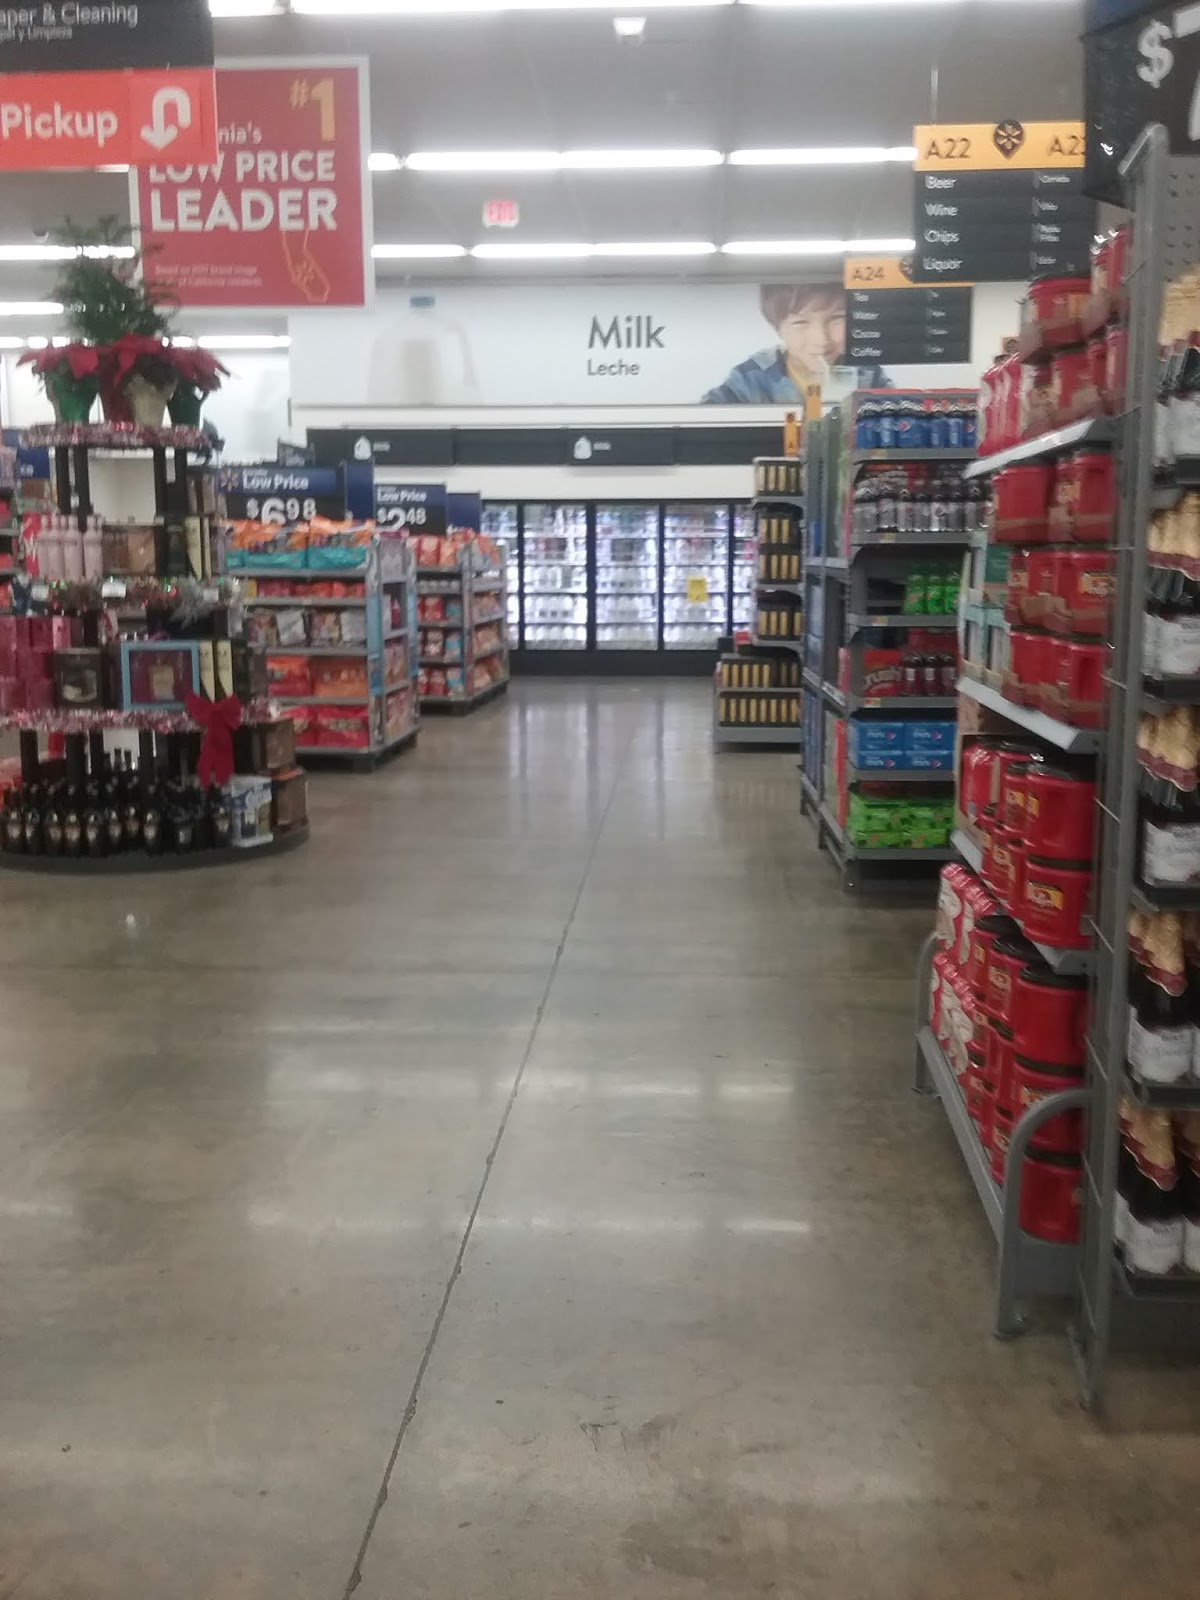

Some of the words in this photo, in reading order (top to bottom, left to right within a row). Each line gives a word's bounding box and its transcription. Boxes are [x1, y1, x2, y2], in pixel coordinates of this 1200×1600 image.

[61, 1, 138, 29] Cleaning
[289, 78, 336, 142] #1
[1, 101, 118, 148] Pickup
[925, 136, 971, 160] A22
[236, 150, 336, 183] PRICE
[925, 175, 957, 189] Beer
[150, 188, 337, 232] LEADER
[925, 202, 958, 216] Wine
[852, 265, 885, 281] A24
[588, 315, 666, 349] Milk
[586, 359, 640, 377] Leche
[273, 473, 309, 490] Price
